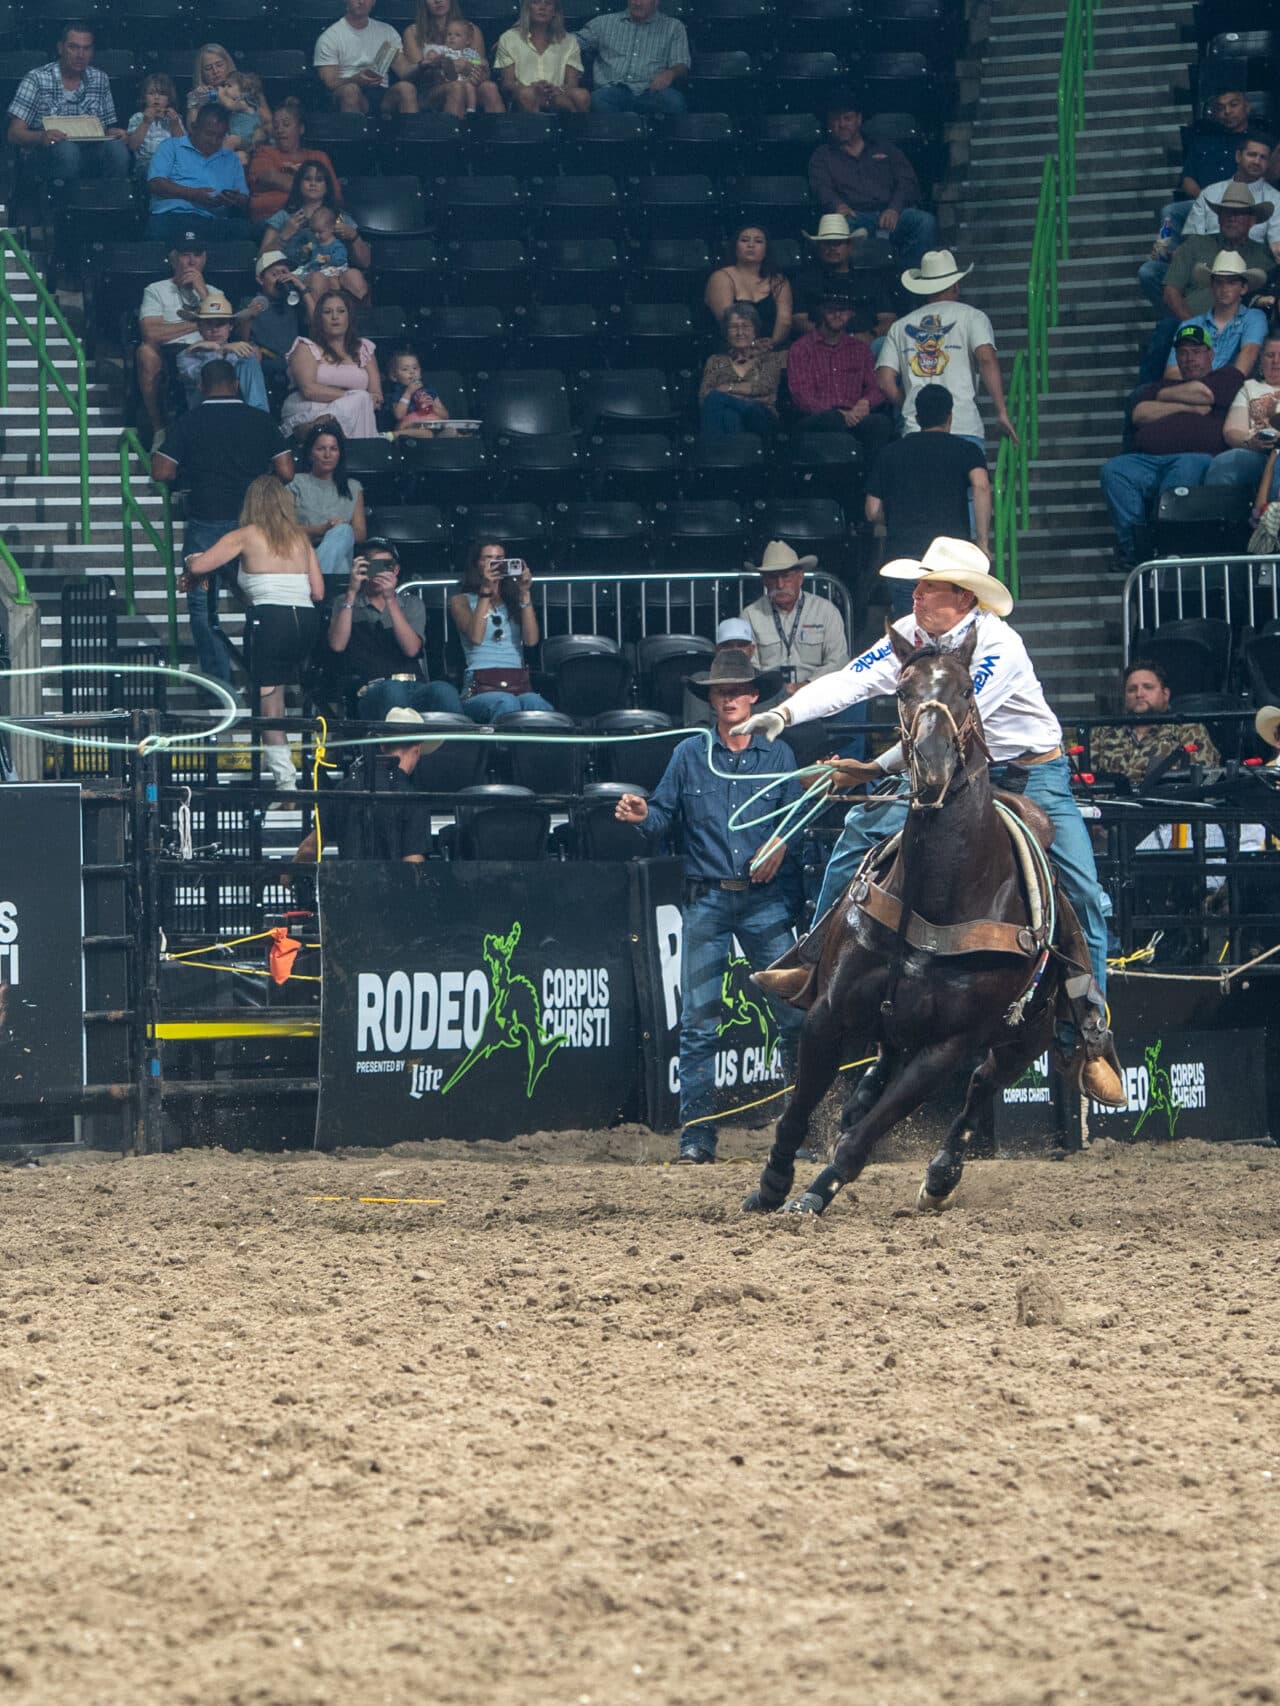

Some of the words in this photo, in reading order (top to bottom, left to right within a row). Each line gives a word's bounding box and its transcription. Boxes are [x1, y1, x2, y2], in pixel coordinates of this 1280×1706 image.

[542, 967, 610, 1008] CORPUS
[357, 969, 489, 1053] RODEO
[541, 1008, 610, 1048] CHRISTI
[356, 1061, 395, 1073] PRESENTED
[396, 1060, 406, 1072] BY
[409, 1063, 443, 1099] Lite
[1170, 1062, 1205, 1086] CORPUS
[1003, 1088, 1027, 1103] CORPUS
[1029, 1087, 1050, 1103] CHRISTI
[1171, 1085, 1207, 1108] CHRISTI
